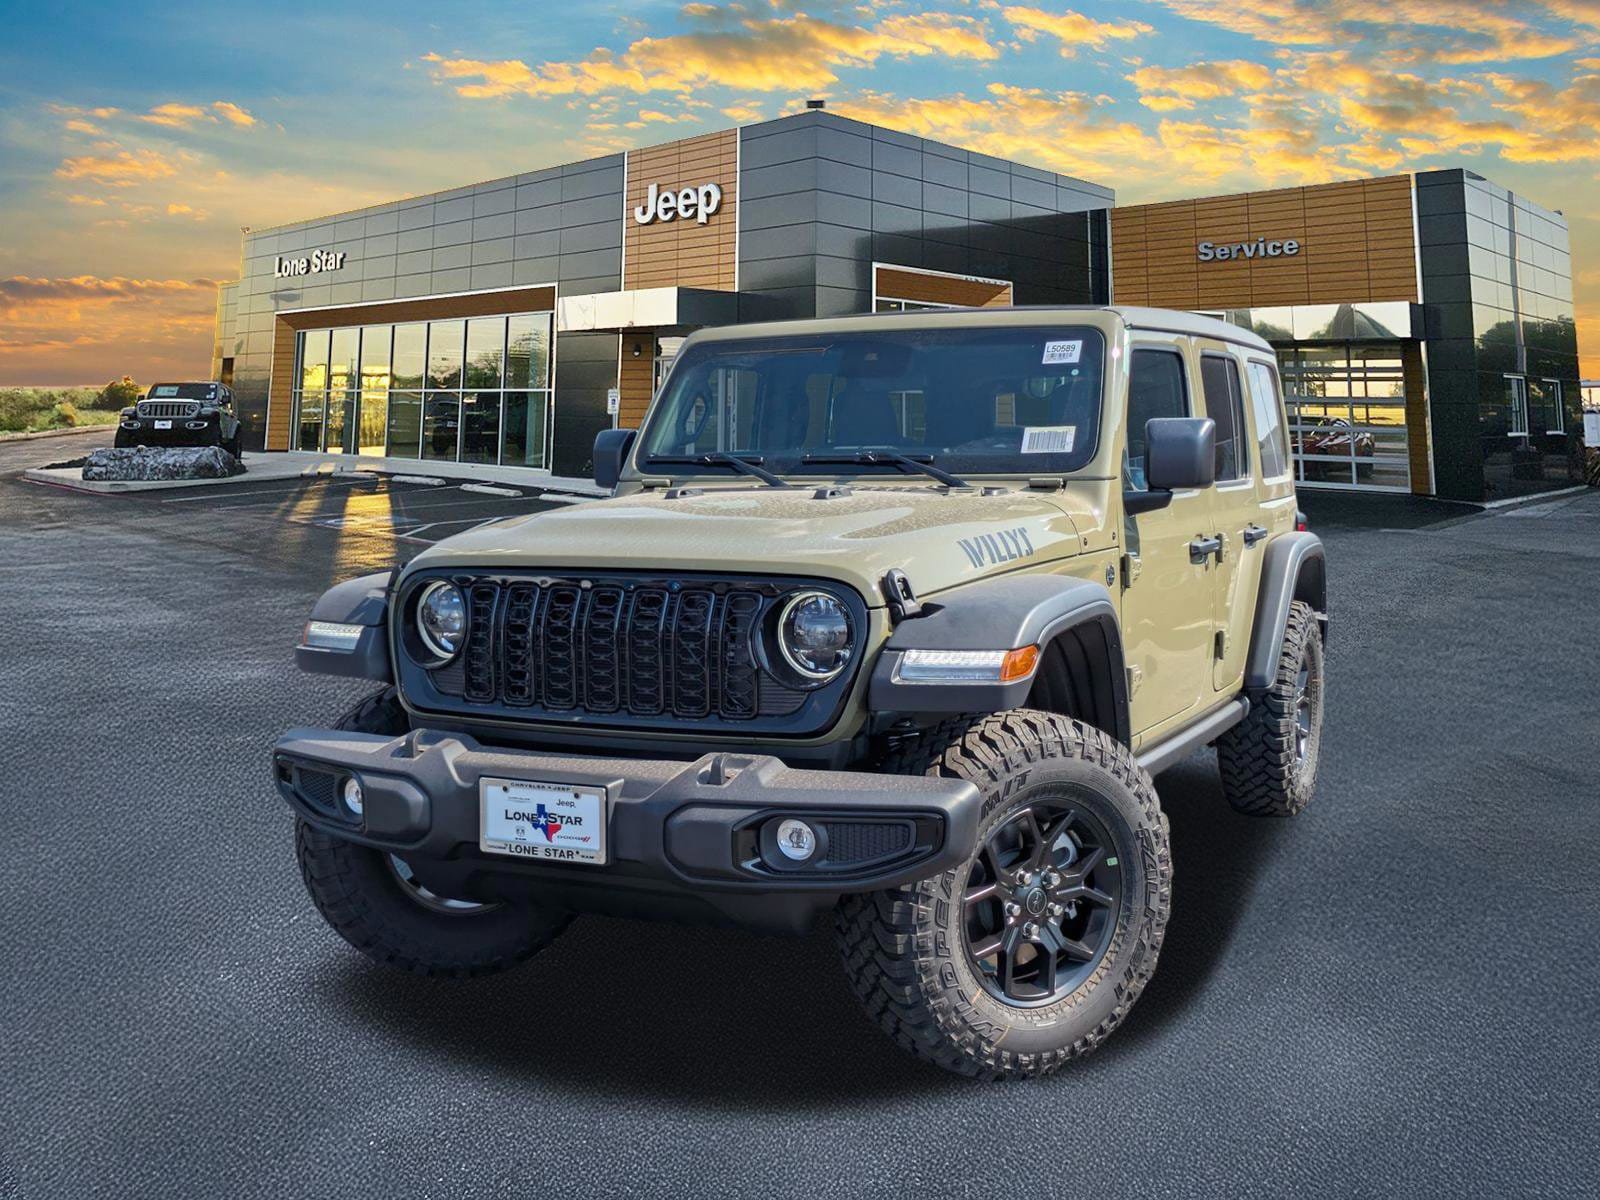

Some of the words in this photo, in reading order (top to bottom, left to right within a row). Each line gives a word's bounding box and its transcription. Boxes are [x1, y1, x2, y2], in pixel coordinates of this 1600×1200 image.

[634, 183, 721, 225] Jeep
[1198, 237, 1299, 261] Service
[275, 256, 310, 278] Lone
[312, 249, 346, 273] Star
[1047, 344, 1076, 353] L50589
[956, 527, 1034, 568] WILLYS
[505, 809, 537, 822] LONE
[547, 812, 583, 826] STAR
[509, 843, 539, 856] LONE
[544, 847, 574, 859] STAR
[935, 870, 1004, 1045] WILDPEA
